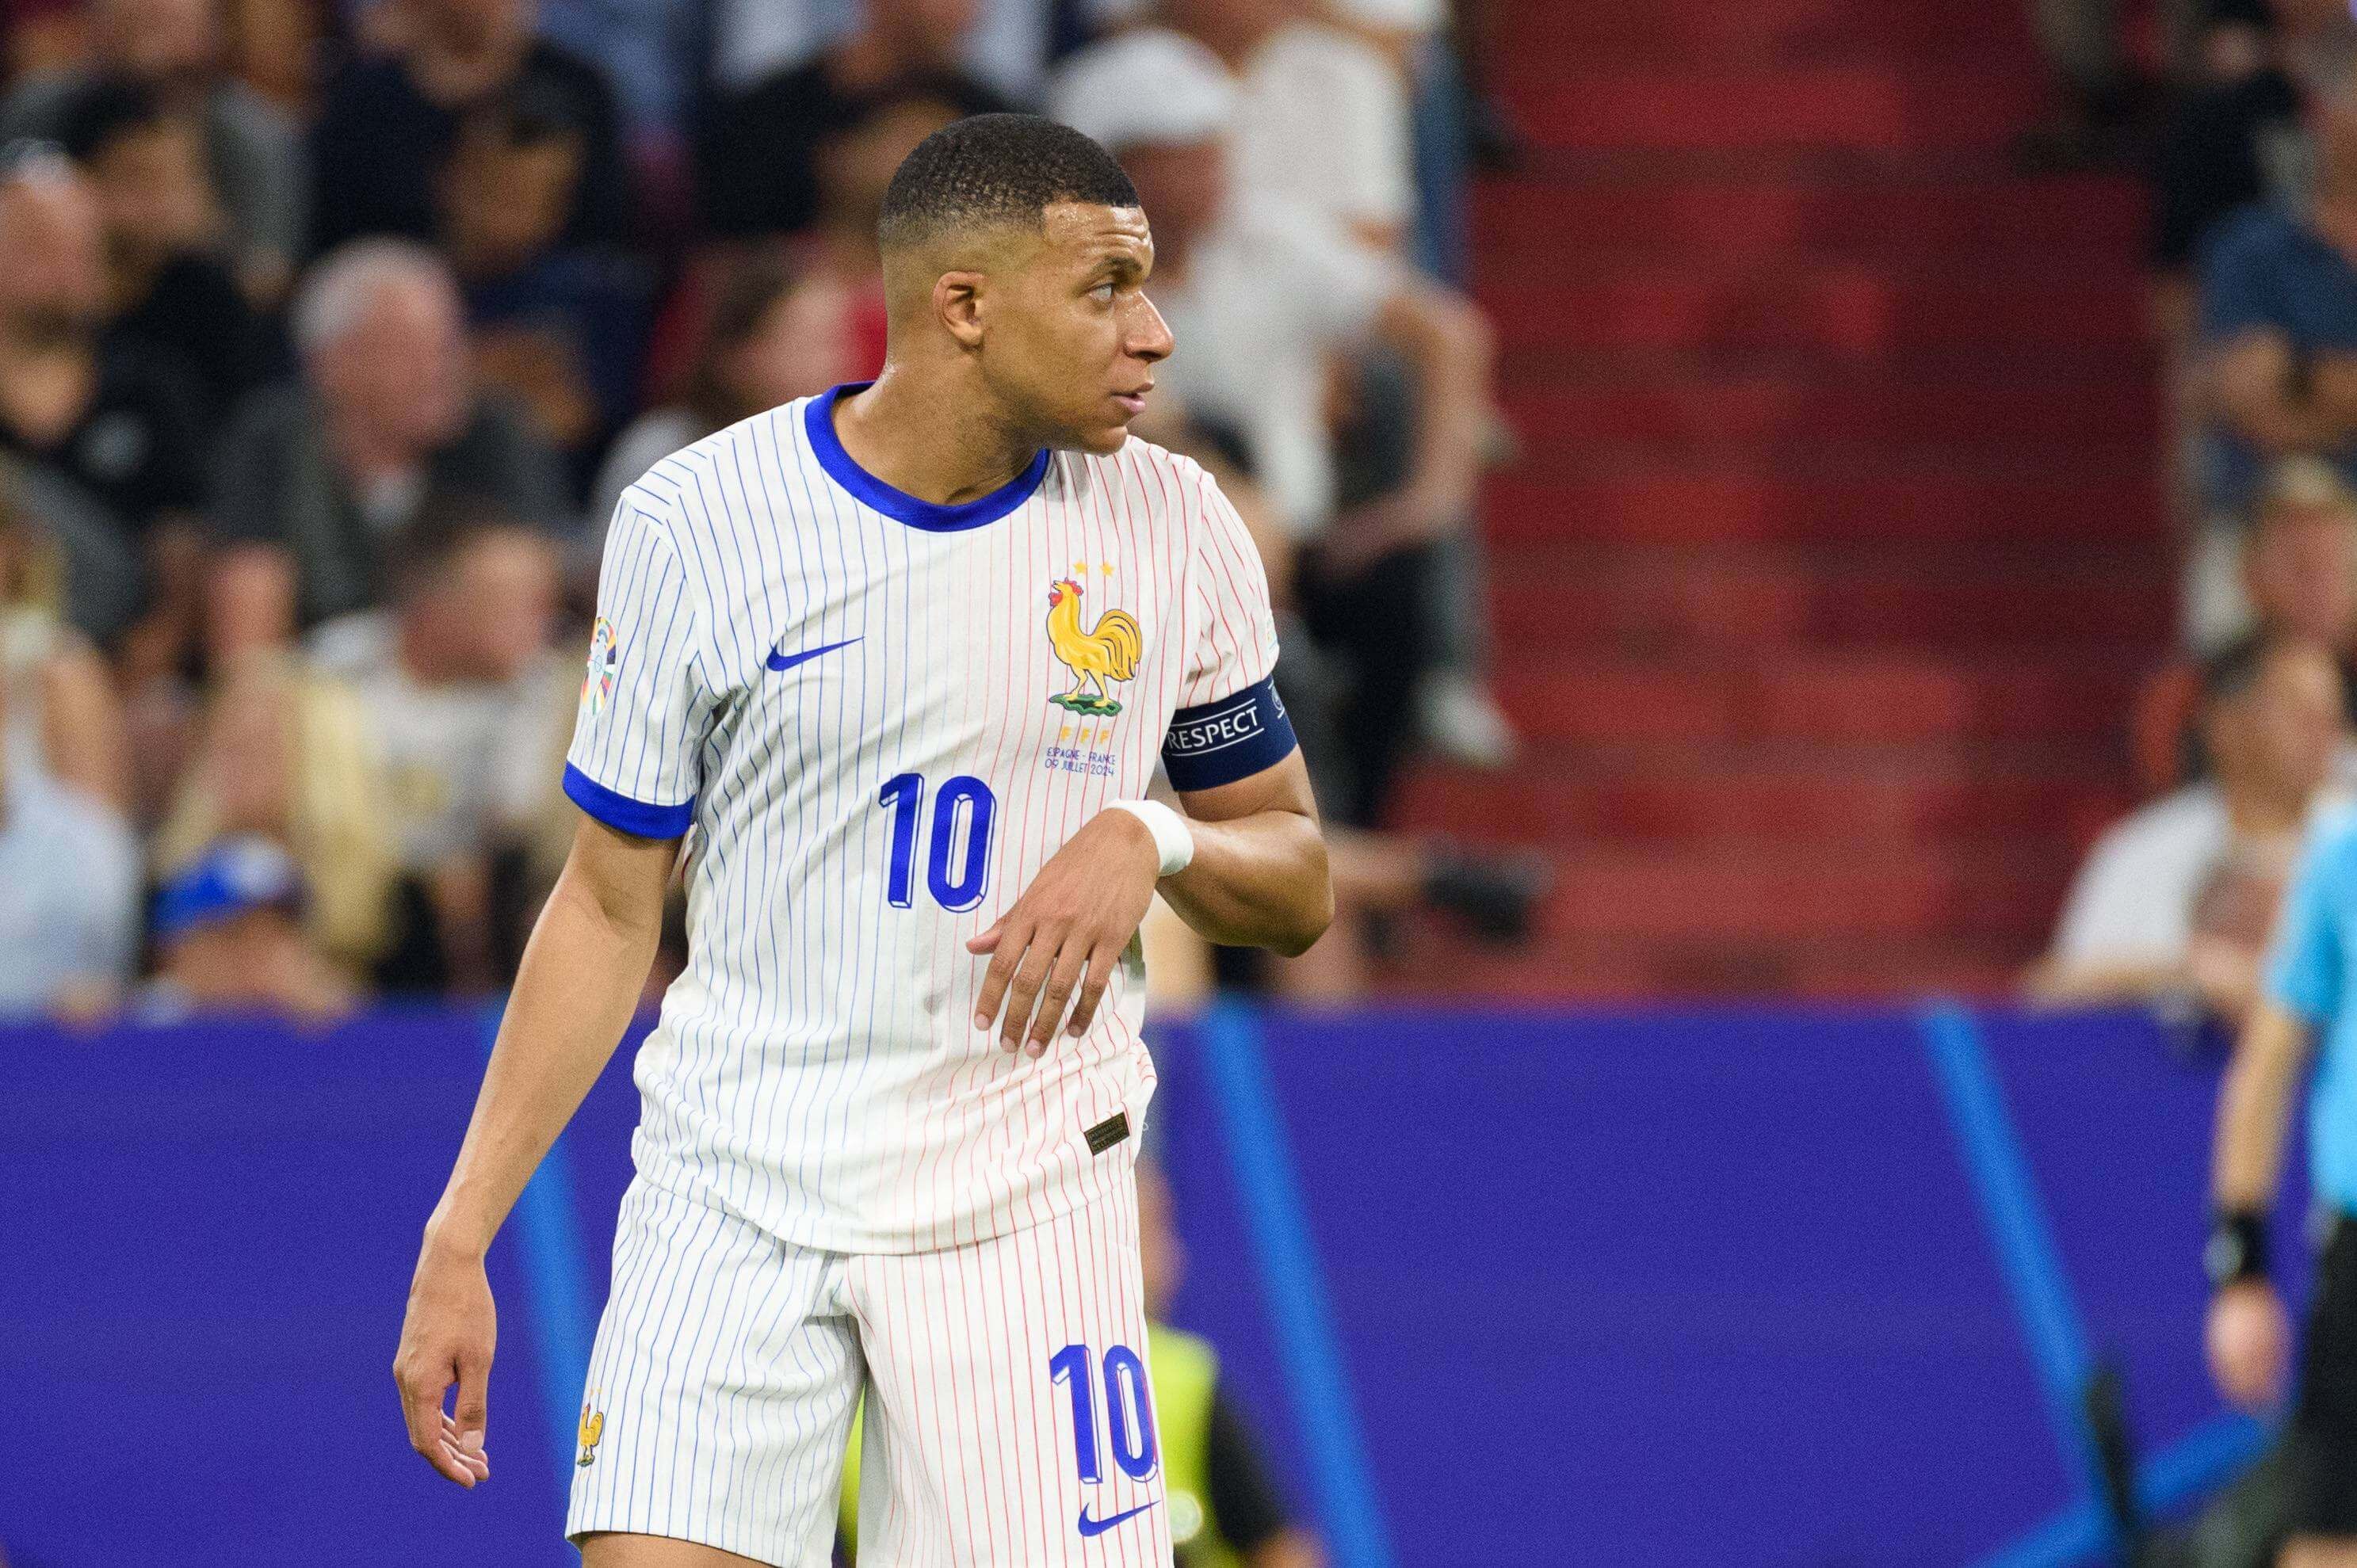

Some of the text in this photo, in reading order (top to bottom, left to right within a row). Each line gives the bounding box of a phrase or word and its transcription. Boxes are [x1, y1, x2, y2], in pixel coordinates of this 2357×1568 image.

[1167, 706, 1258, 750] RESPECT
[1045, 758, 1059, 769] 09
[1091, 764, 1115, 777] 2024
[1089, 751, 1116, 765] FRANCE
[879, 773, 997, 913] 10
[1049, 1345, 1159, 1484] 10
